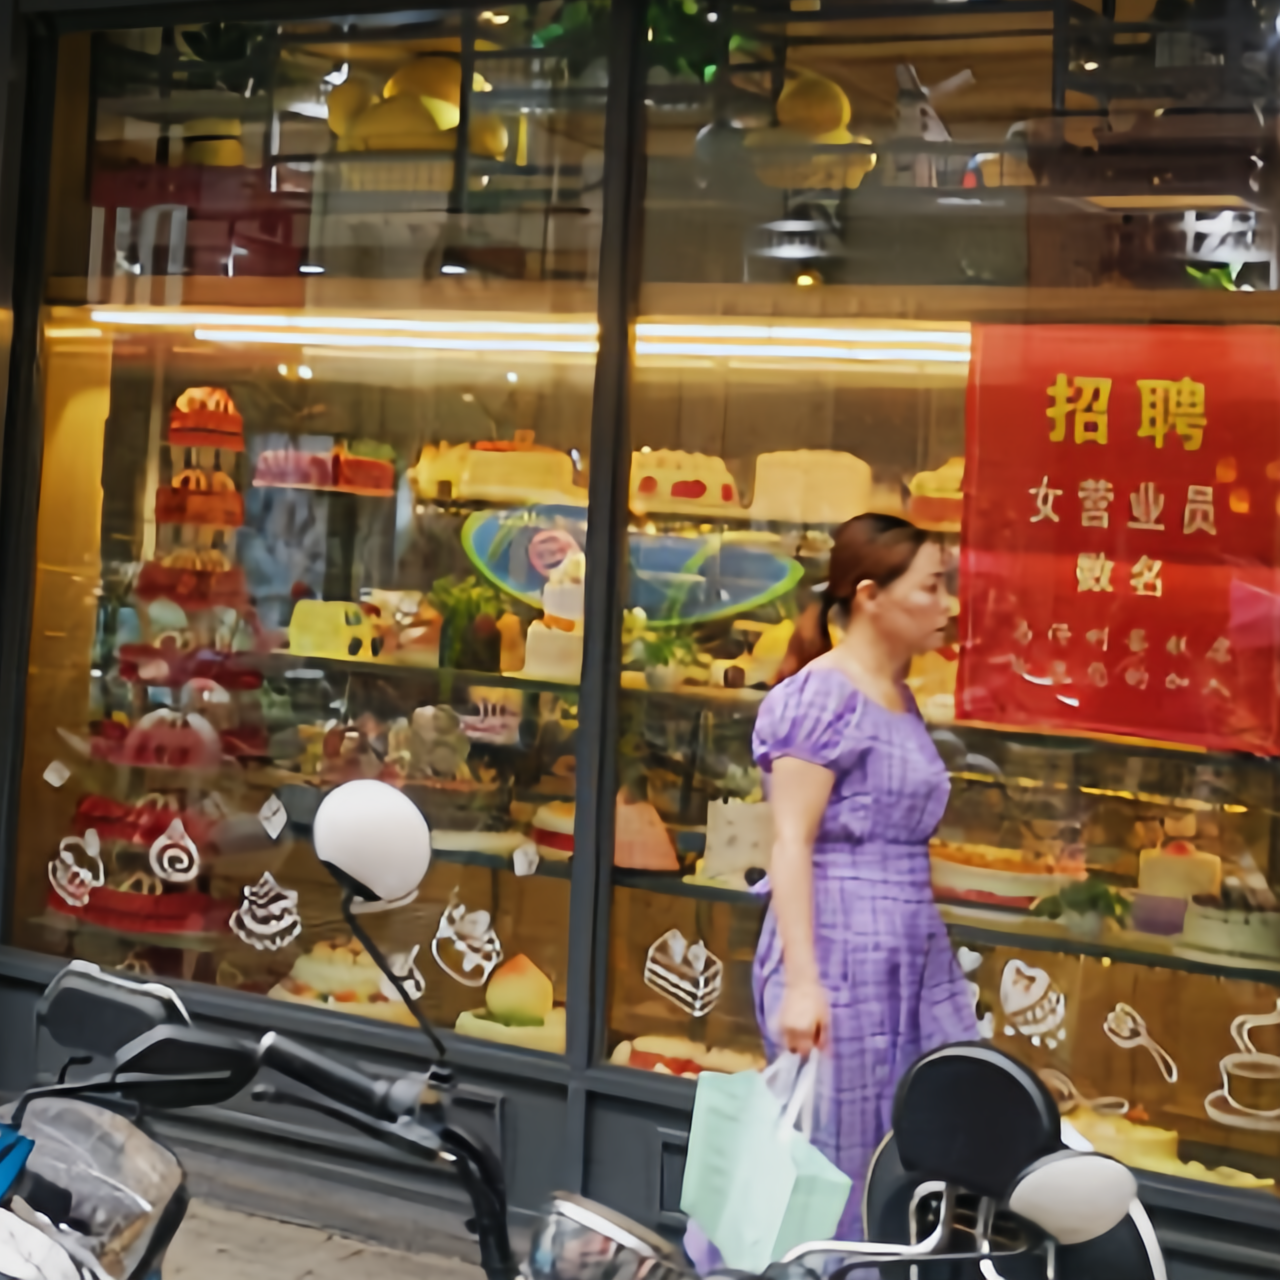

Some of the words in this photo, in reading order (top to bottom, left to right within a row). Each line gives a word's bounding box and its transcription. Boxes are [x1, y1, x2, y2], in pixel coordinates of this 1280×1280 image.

[1045, 372, 1208, 451] 招聘
[1028, 475, 1218, 536] 女营业员
